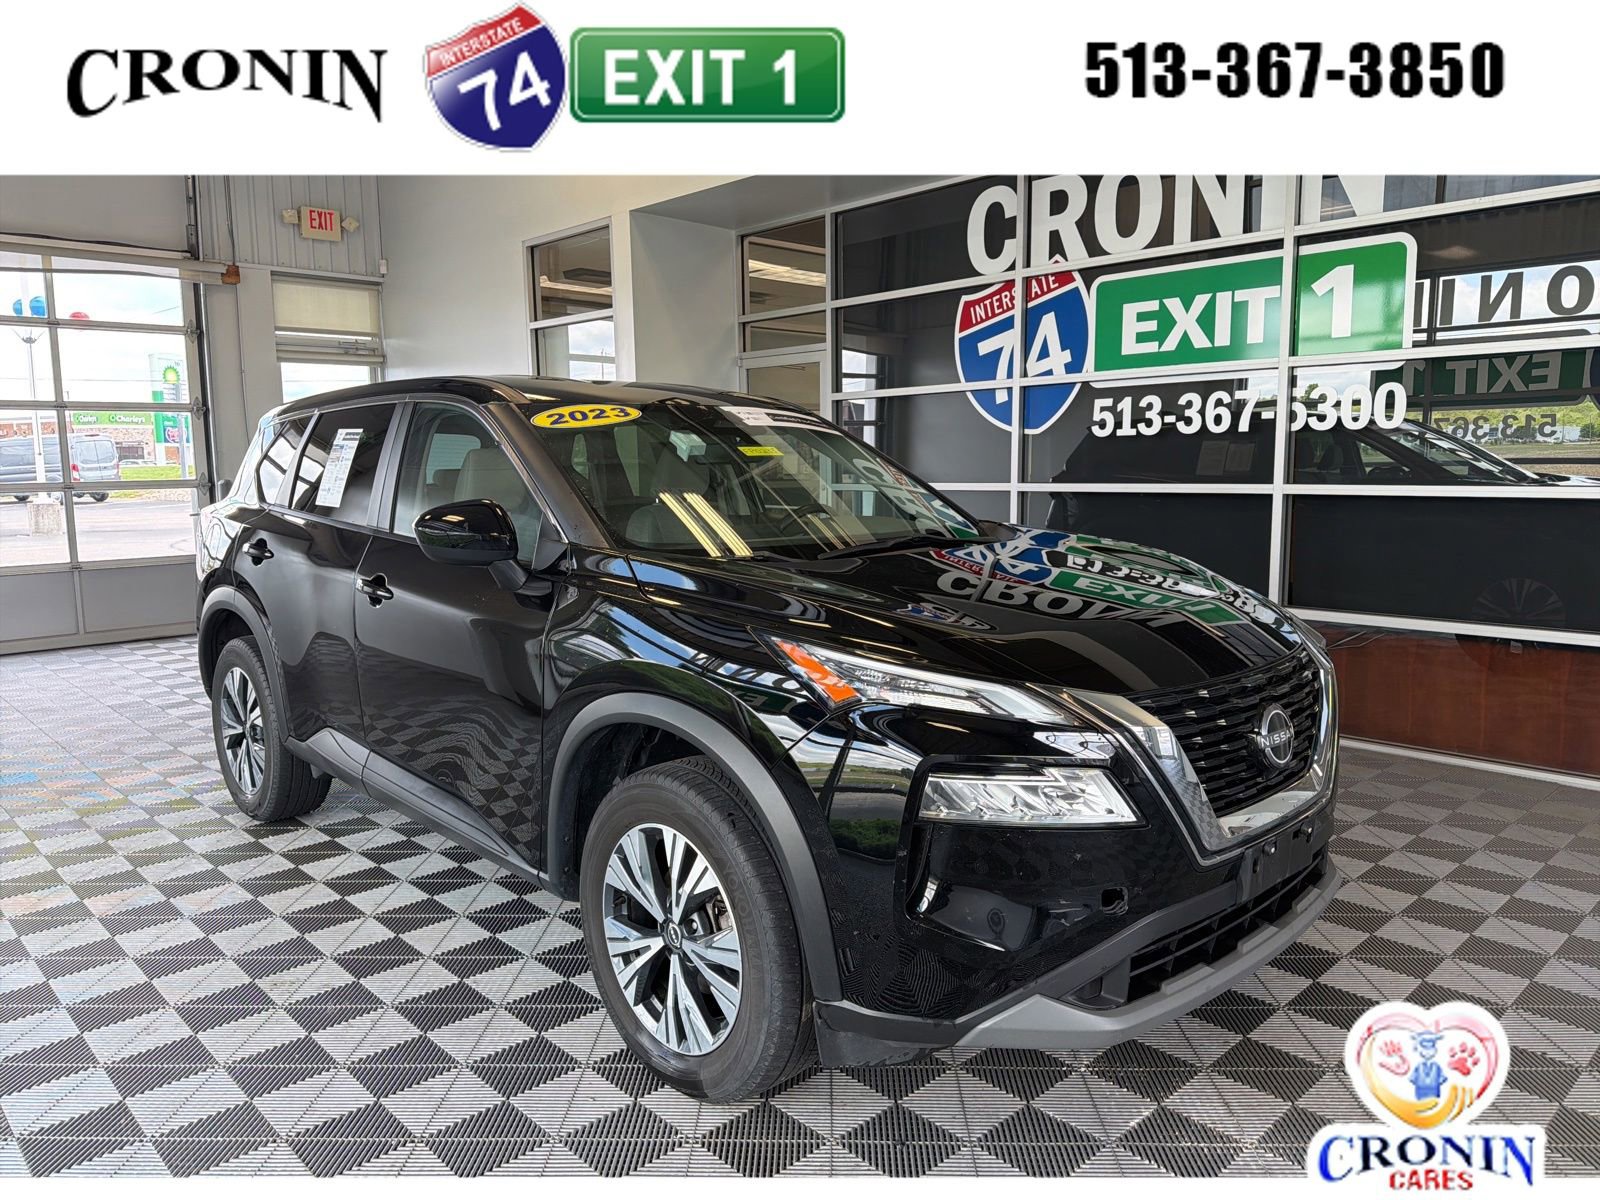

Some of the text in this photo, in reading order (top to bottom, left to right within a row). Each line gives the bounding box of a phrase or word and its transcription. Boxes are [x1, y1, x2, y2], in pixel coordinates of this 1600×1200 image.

[308, 208, 335, 231] EXIT
[1121, 264, 1354, 355] EXIT 1
[977, 311, 1073, 405] 74
[546, 407, 633, 426] 2023
